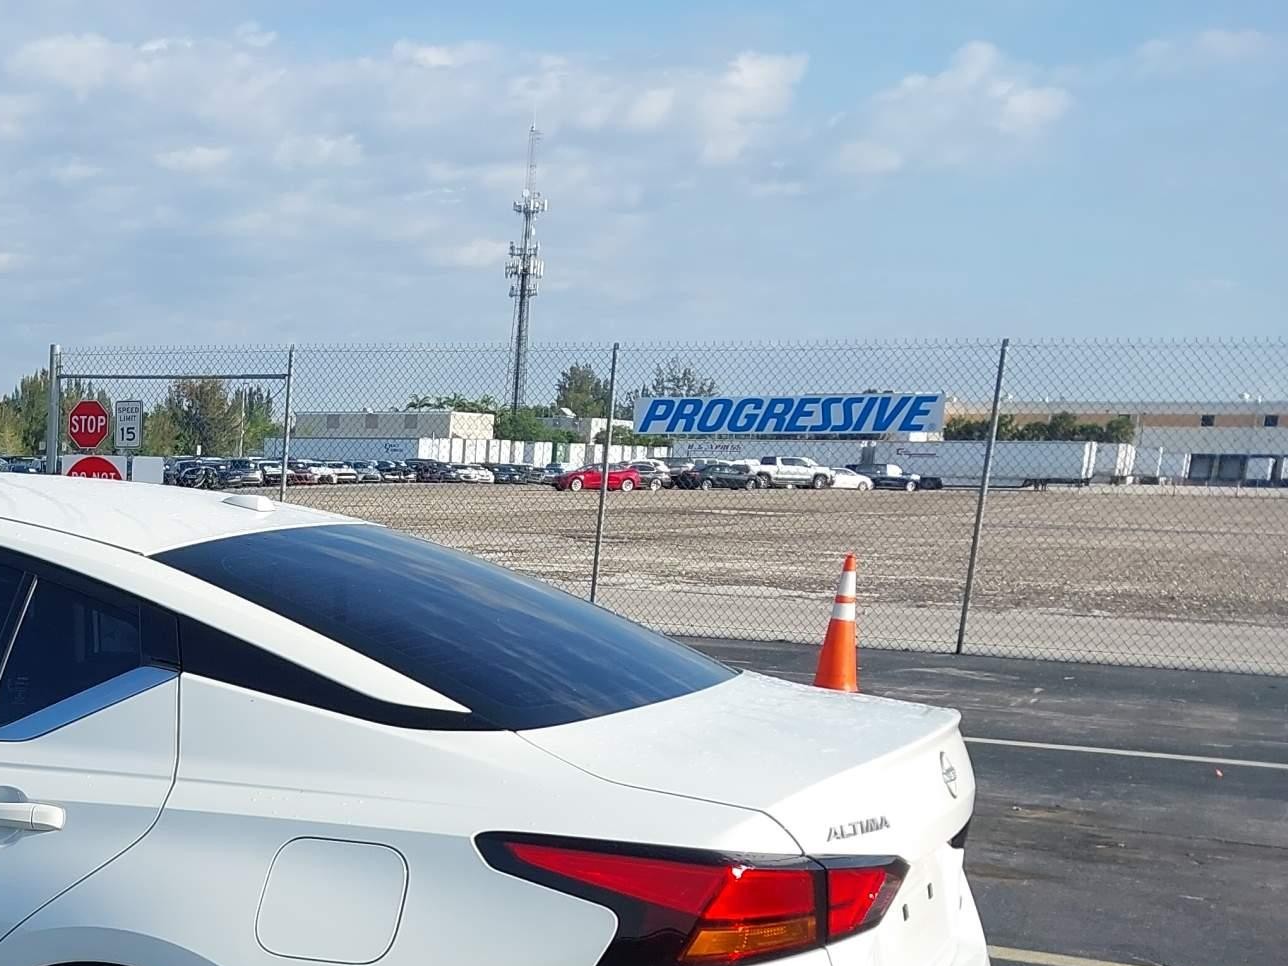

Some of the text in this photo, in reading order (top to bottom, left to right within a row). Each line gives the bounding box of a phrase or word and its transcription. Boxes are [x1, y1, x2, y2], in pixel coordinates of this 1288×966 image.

[638, 395, 939, 433] PROGRESSIVE
[71, 415, 106, 433] STOP
[120, 426, 136, 442] 15
[92, 471, 116, 480] NOT
[826, 816, 891, 842] ALTIMA
